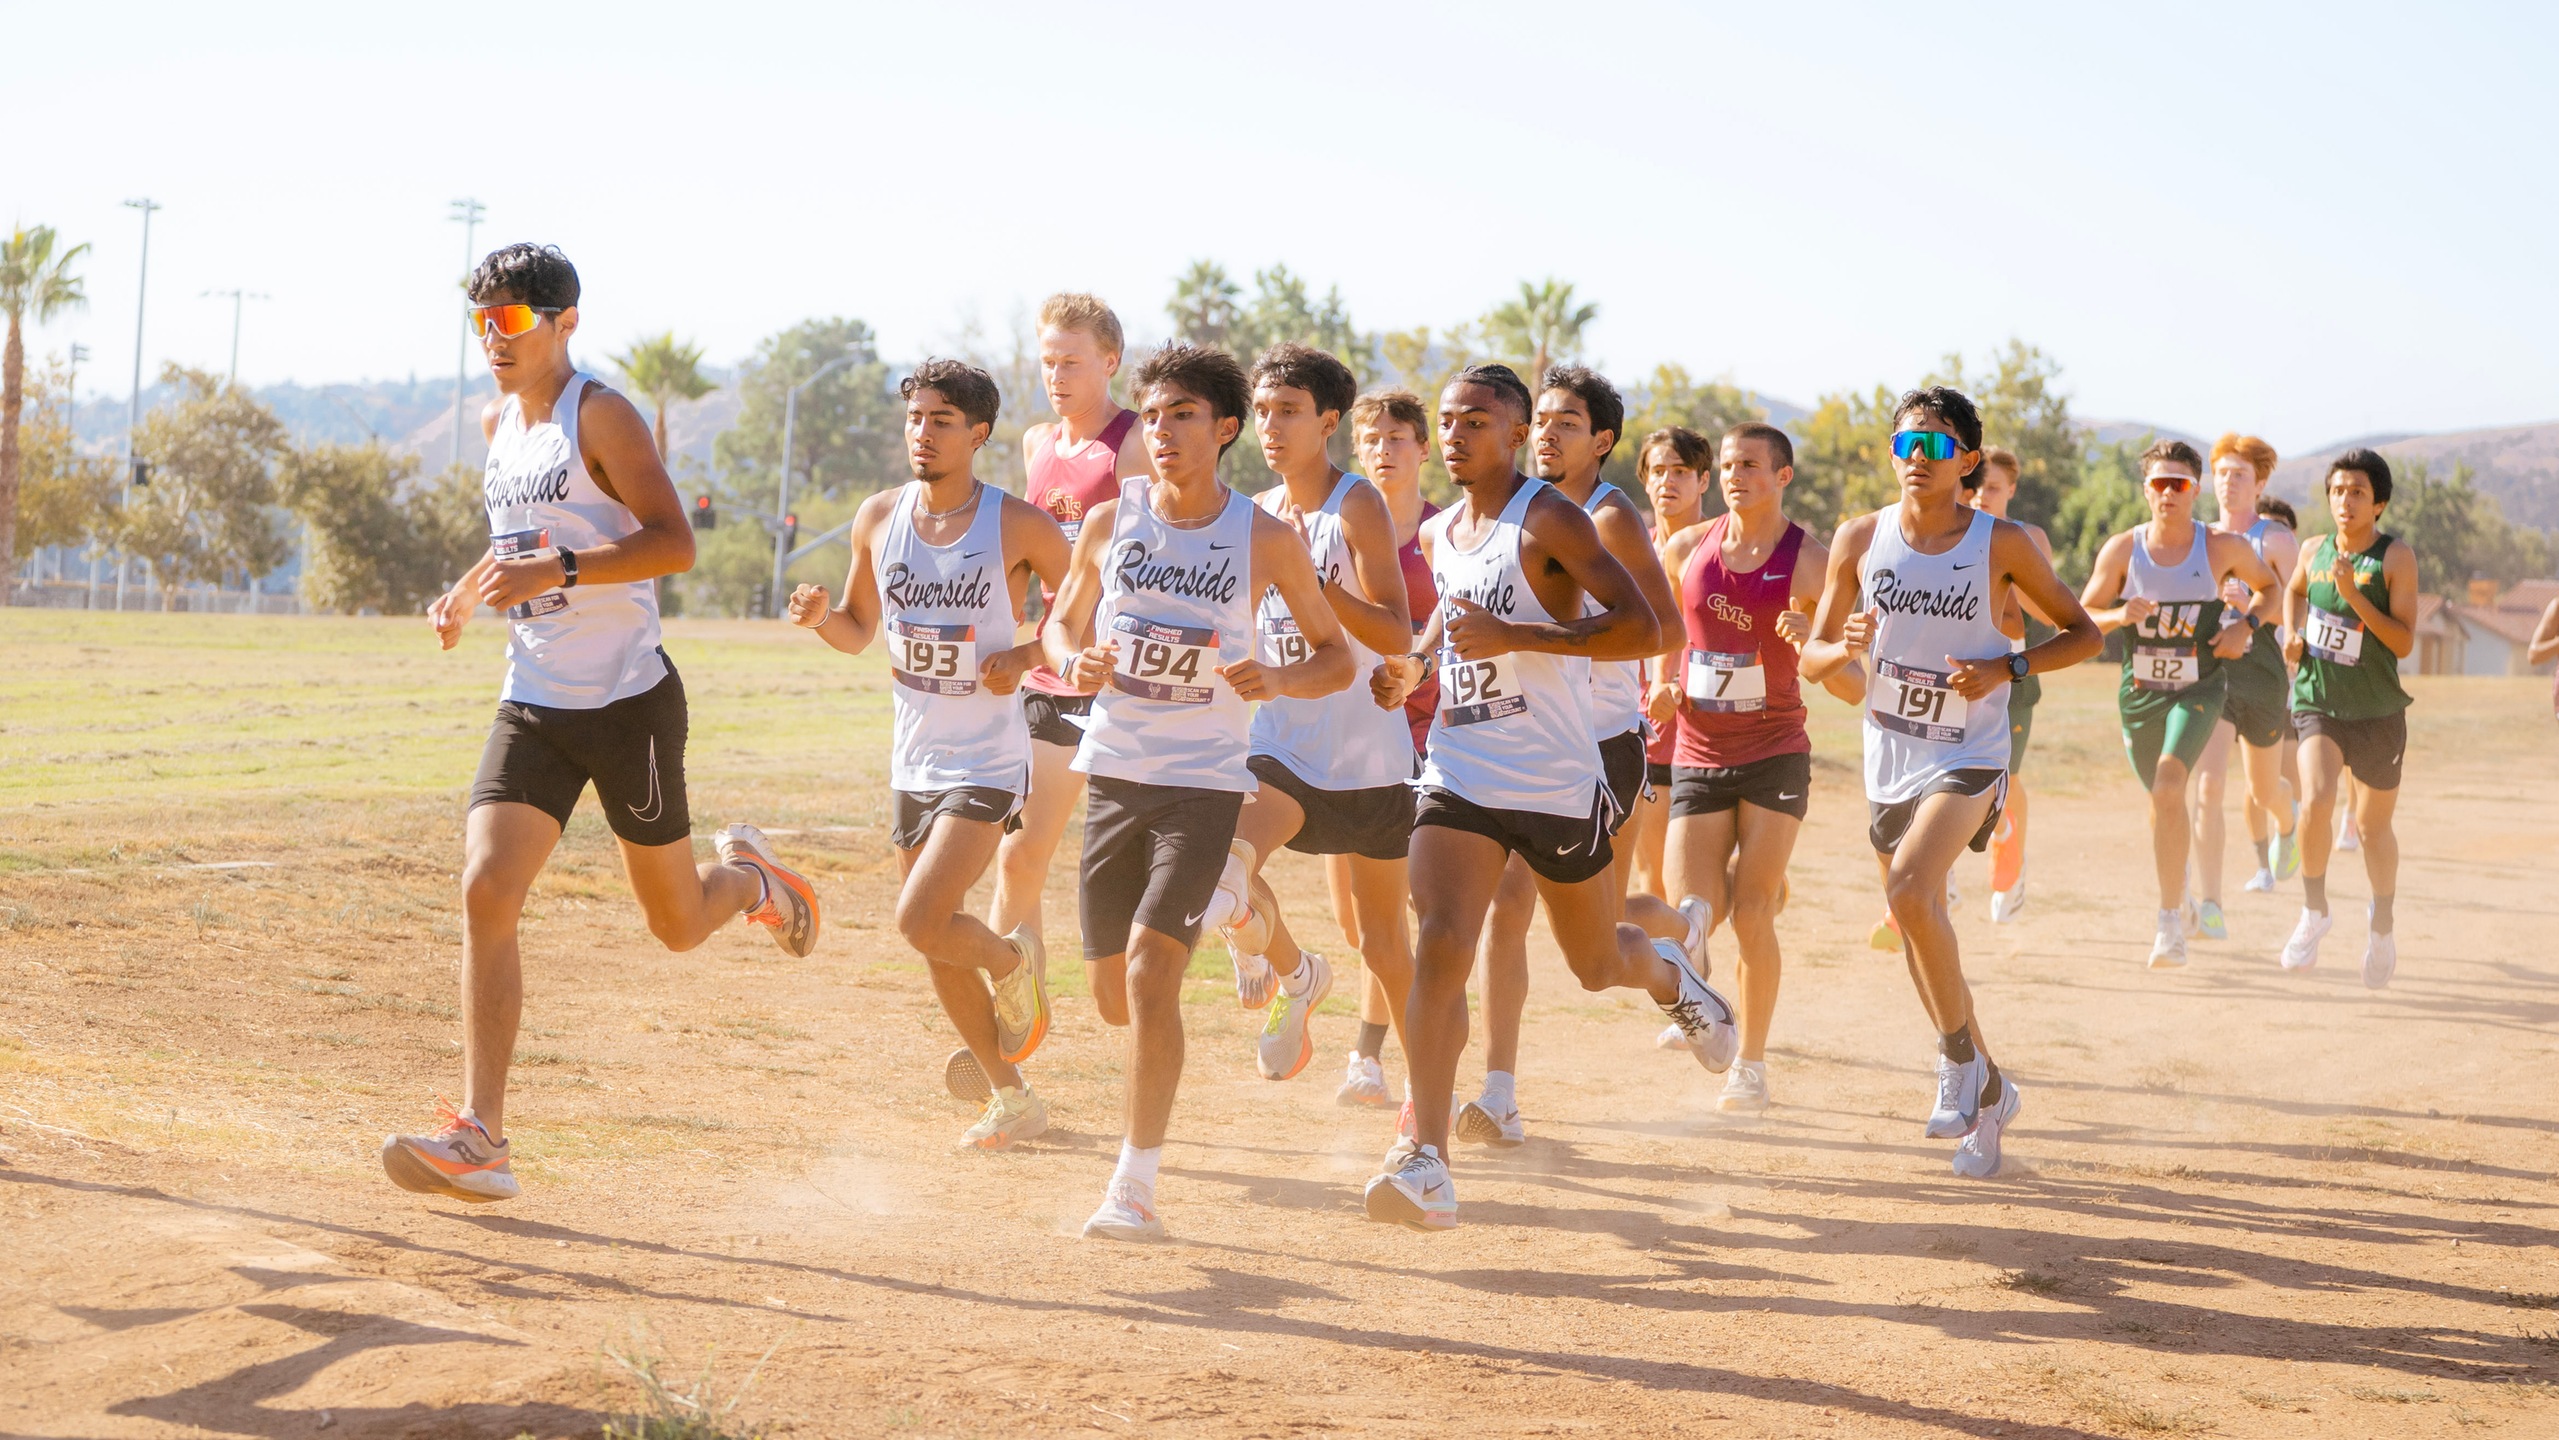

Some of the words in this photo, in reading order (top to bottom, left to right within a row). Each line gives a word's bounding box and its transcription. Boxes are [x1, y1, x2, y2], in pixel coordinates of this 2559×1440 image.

[486, 453, 569, 513] Riverside
[886, 562, 991, 611] Riverside
[1115, 541, 1237, 604] Riverside
[1707, 593, 1752, 632] CMS
[1872, 568, 1979, 622] Riverside
[913, 626, 941, 634] FINISHED
[1148, 632, 1180, 643] RESULTS
[1150, 624, 1183, 636] FINISHED
[2317, 624, 2348, 651] 113
[903, 639, 959, 677] 193
[1129, 638, 1201, 684] 194
[1276, 635, 1313, 667] 19
[1450, 661, 1502, 705] 192
[1715, 669, 1734, 698] 7
[1907, 677, 1935, 686] RESULTS
[1909, 670, 1938, 680] FINISHED
[2151, 659, 2183, 680] 82
[1897, 684, 1947, 723] 191
